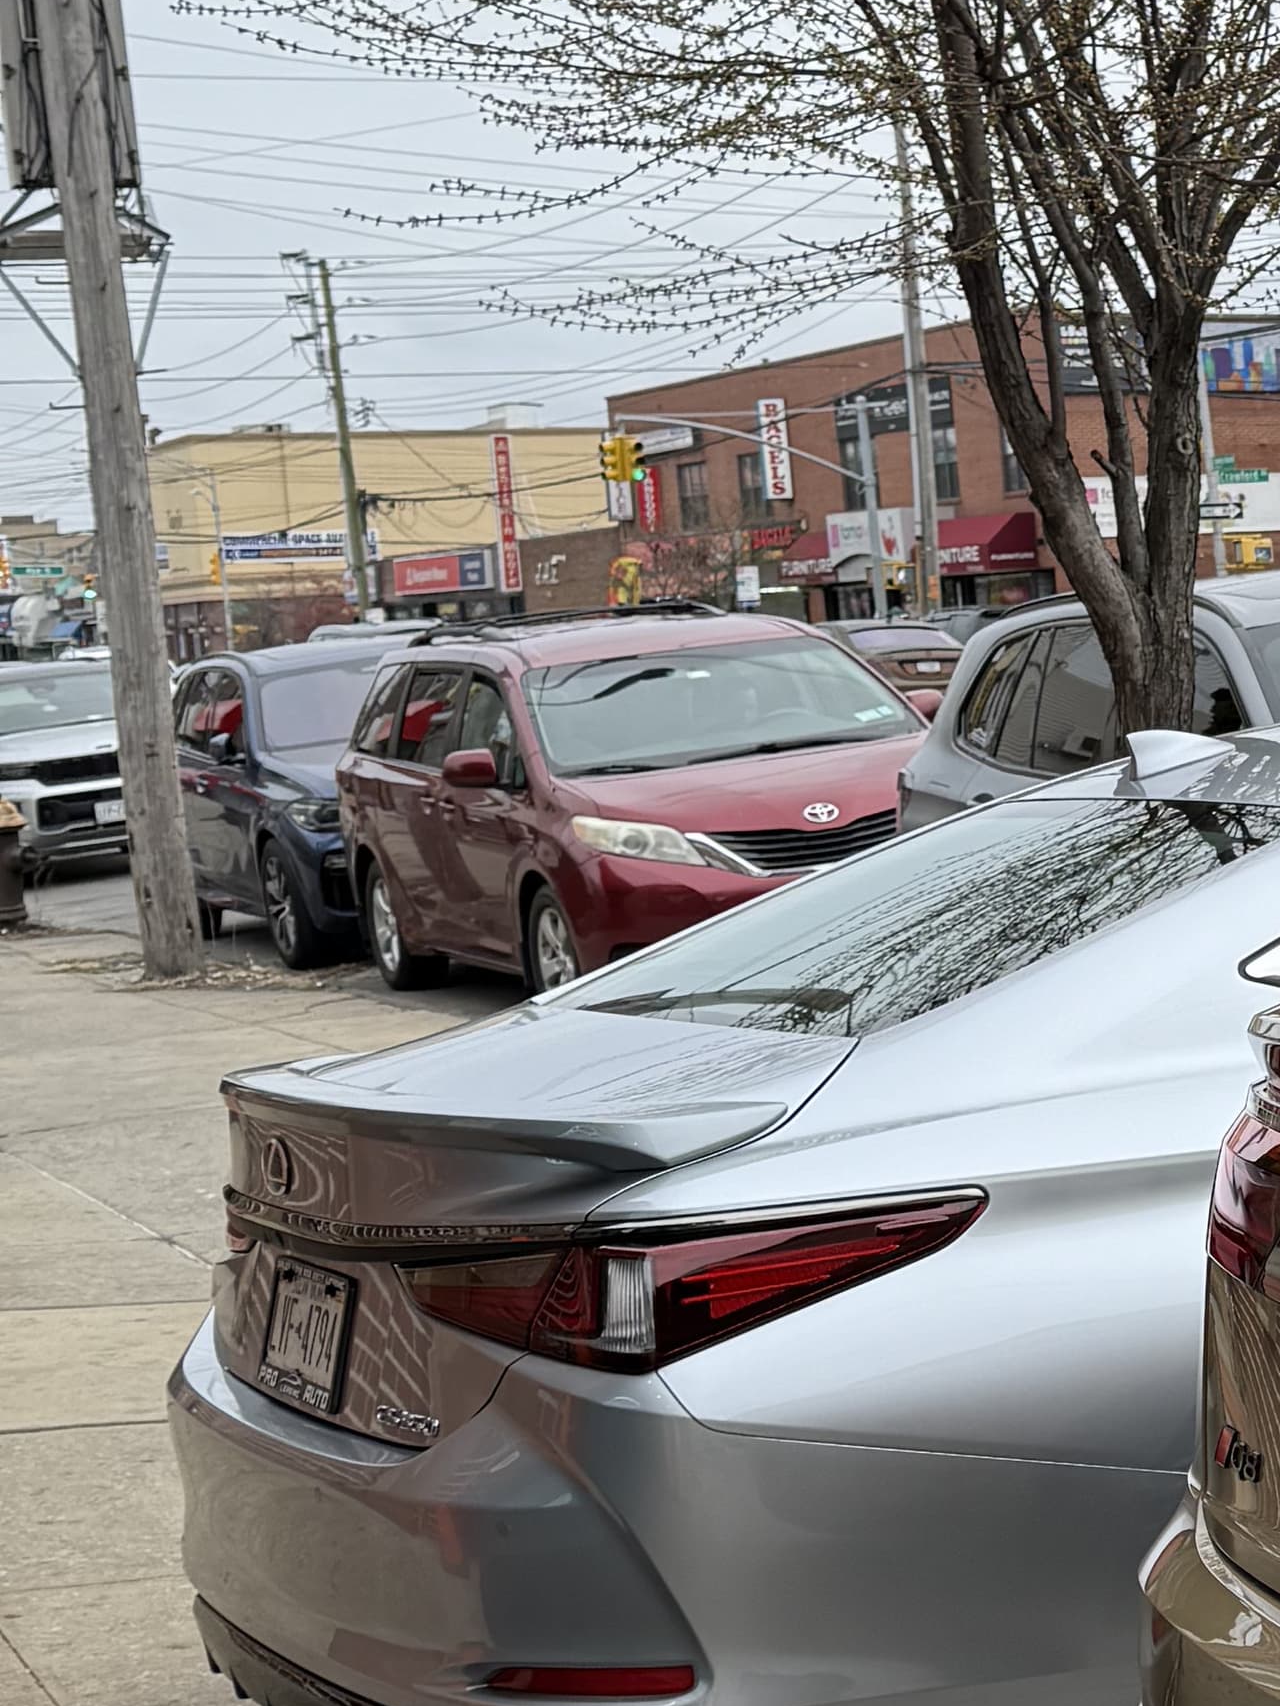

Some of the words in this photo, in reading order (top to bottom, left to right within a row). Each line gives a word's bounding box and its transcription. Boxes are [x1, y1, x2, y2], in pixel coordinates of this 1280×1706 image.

[763, 403, 786, 496] BAGELS
[781, 559, 833, 577] FURNITURE
[938, 545, 980, 564] NITURE
[258, 1365, 278, 1387] PRO
[303, 1385, 330, 1410] AUTO
